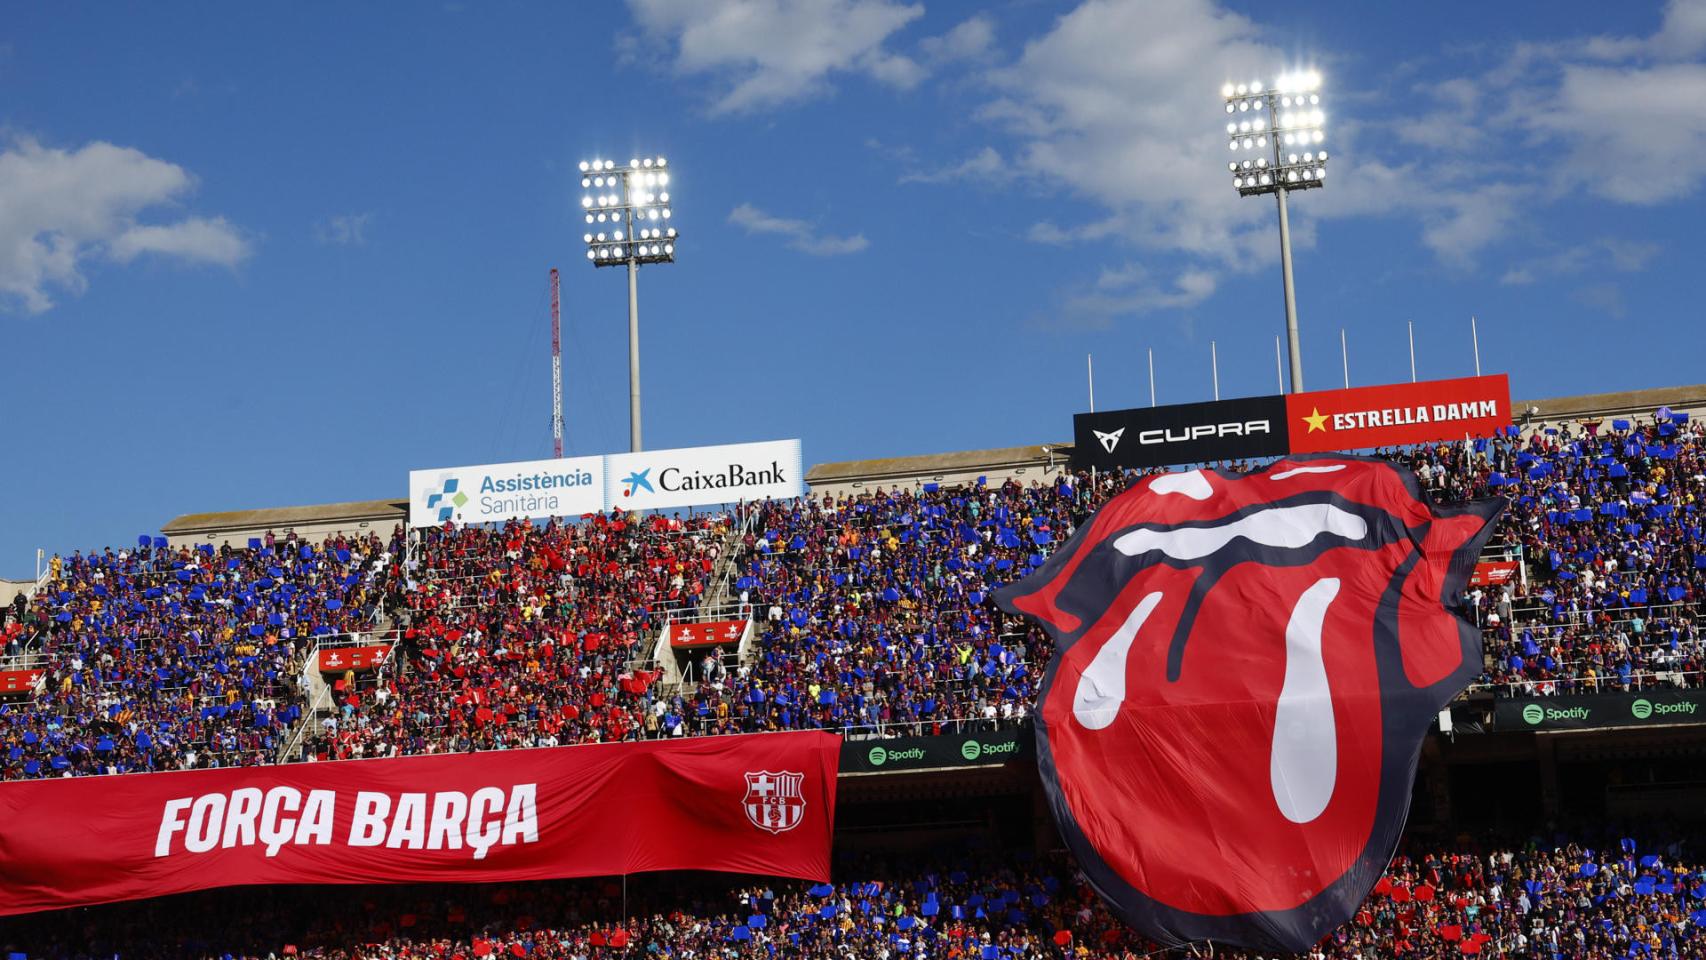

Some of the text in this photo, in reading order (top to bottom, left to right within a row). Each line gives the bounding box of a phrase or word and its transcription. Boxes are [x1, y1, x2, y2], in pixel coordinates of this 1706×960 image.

[1333, 400, 1497, 431] ESTRELLA DAMM
[1139, 420, 1270, 445] CUPRA
[480, 469, 592, 493] Assistència
[659, 461, 786, 492] CaixaBank
[480, 493, 559, 515] Sanitària
[1546, 707, 1589, 720] Spotify
[1654, 701, 1697, 714] Spotify
[888, 748, 924, 761] Spotify
[154, 783, 539, 860] FORÇA BARÇA
